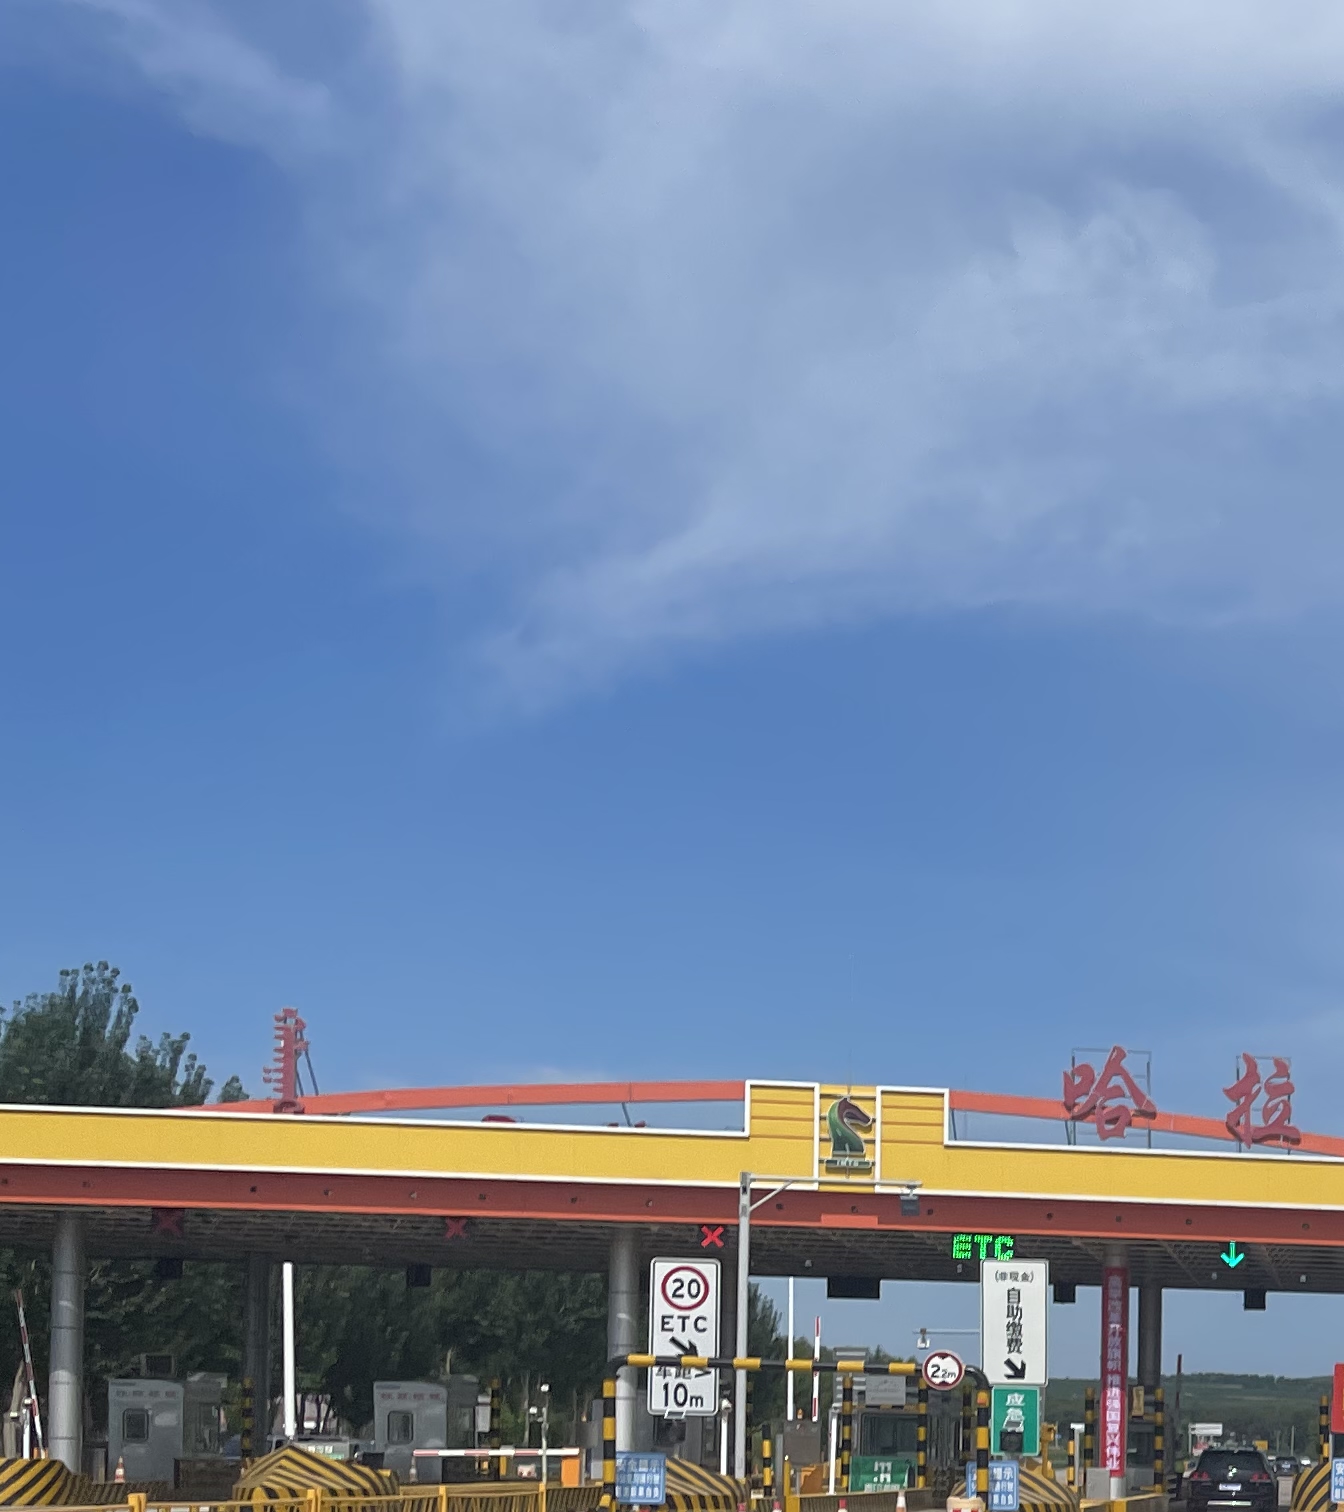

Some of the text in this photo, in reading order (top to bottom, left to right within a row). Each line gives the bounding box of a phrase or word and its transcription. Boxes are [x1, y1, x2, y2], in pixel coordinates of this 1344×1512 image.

[953, 1234, 1014, 1261] ETC
[671, 1278, 701, 1299] 20
[660, 1315, 708, 1333] ETC
[1006, 1287, 1023, 1354] 自助缴费
[663, 1383, 704, 1408] 10m
